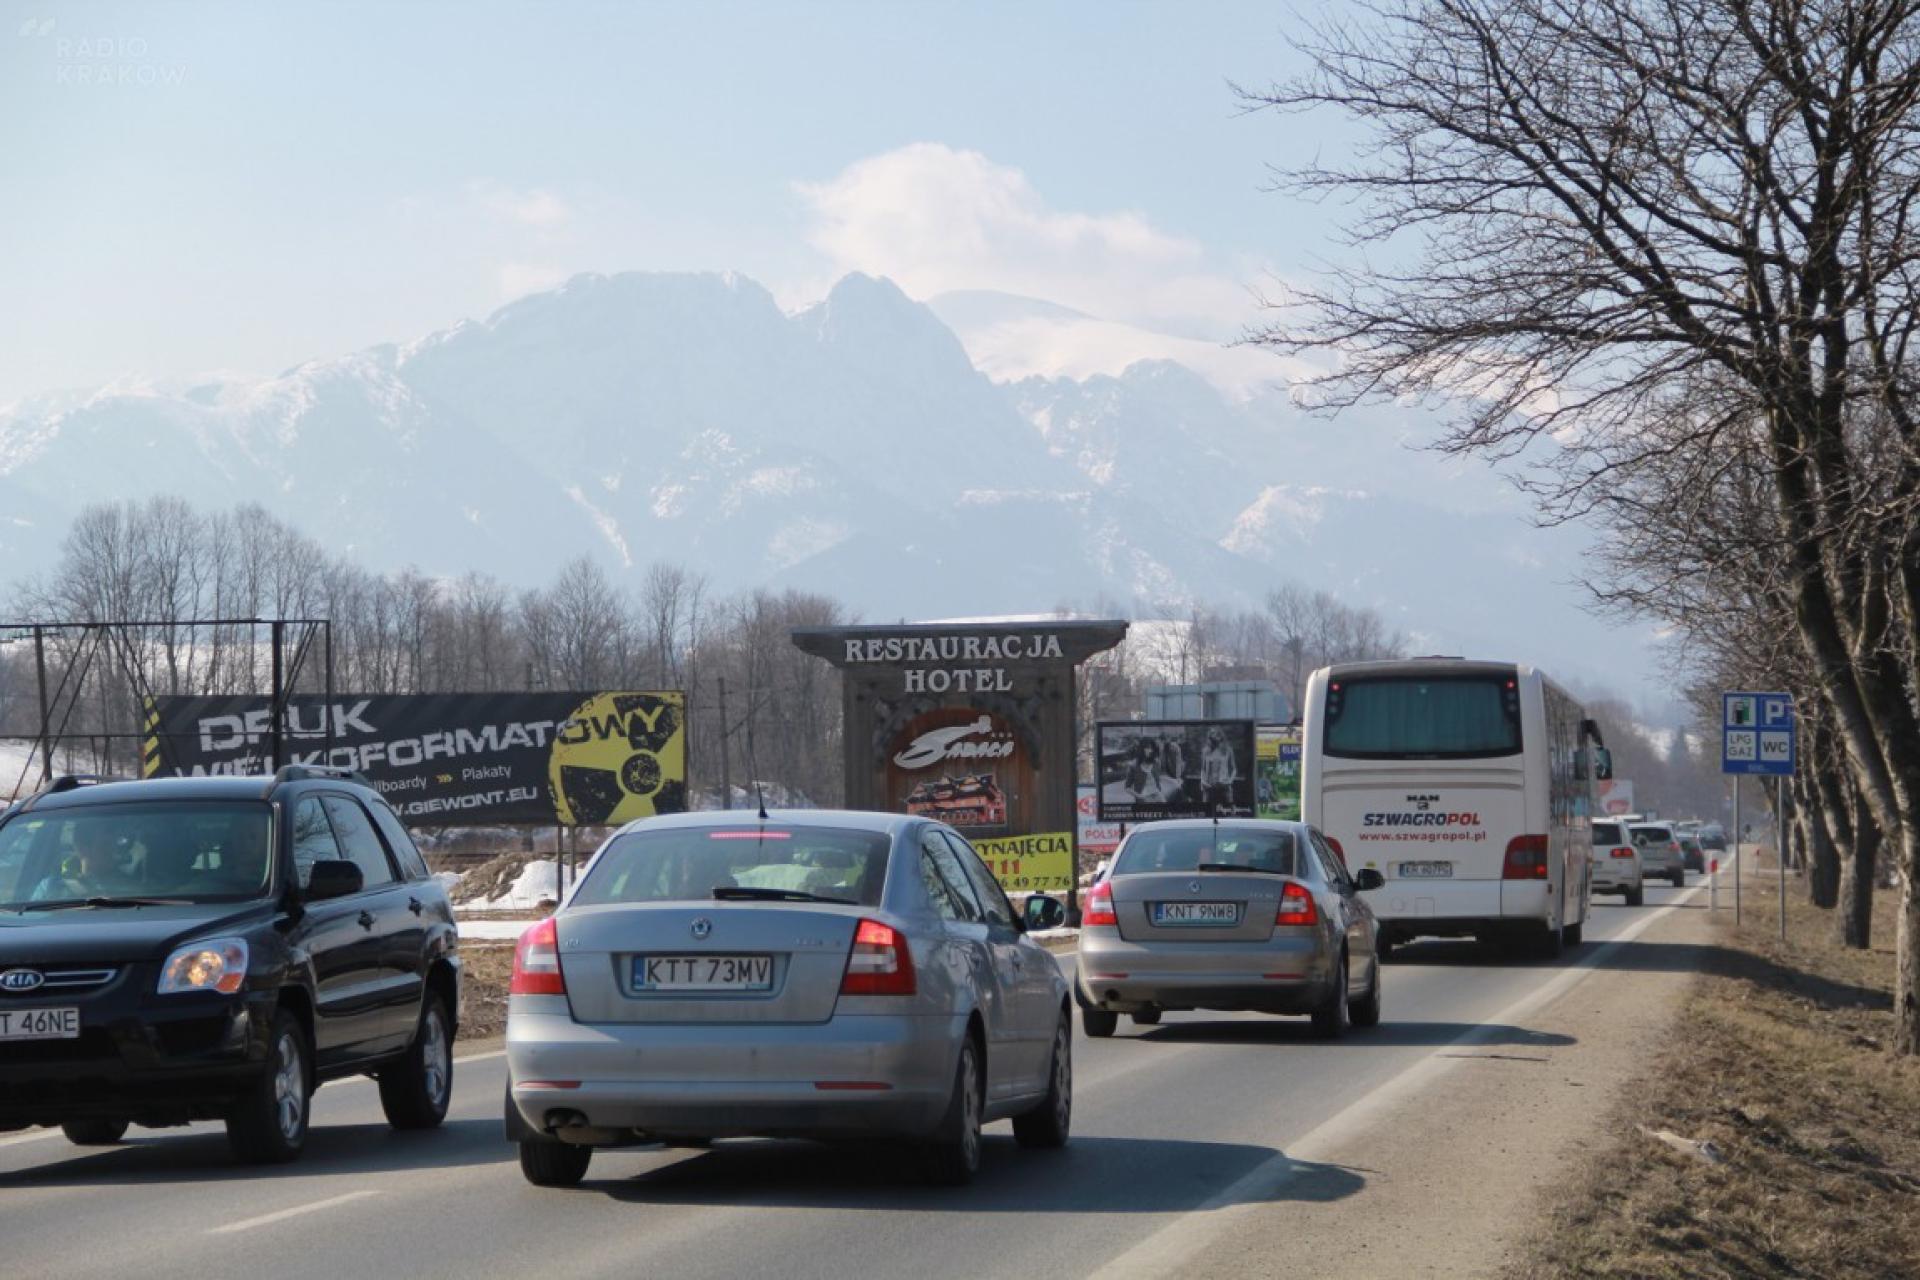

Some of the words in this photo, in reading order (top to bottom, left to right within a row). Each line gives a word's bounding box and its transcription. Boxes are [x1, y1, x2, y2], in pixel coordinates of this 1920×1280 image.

[844, 634, 1064, 662] RESTAURACJA
[904, 667, 1013, 693] HOTEL
[1765, 701, 1784, 725] P
[198, 700, 377, 752] DRUK
[1763, 741, 1788, 753] WC
[462, 765, 512, 782] Plakaty
[393, 786, 539, 816] .GIEWONT.EU
[1406, 794, 1440, 802] MAN
[1363, 812, 1481, 827] SZWAGROPOL
[1358, 830, 1487, 842] www.szwagropol.pl
[1166, 905, 1193, 919] KNT
[6, 973, 35, 985] KIA
[647, 958, 697, 984] KTT
[707, 958, 770, 984] 73MV
[21, 1010, 77, 1033] 46NE
